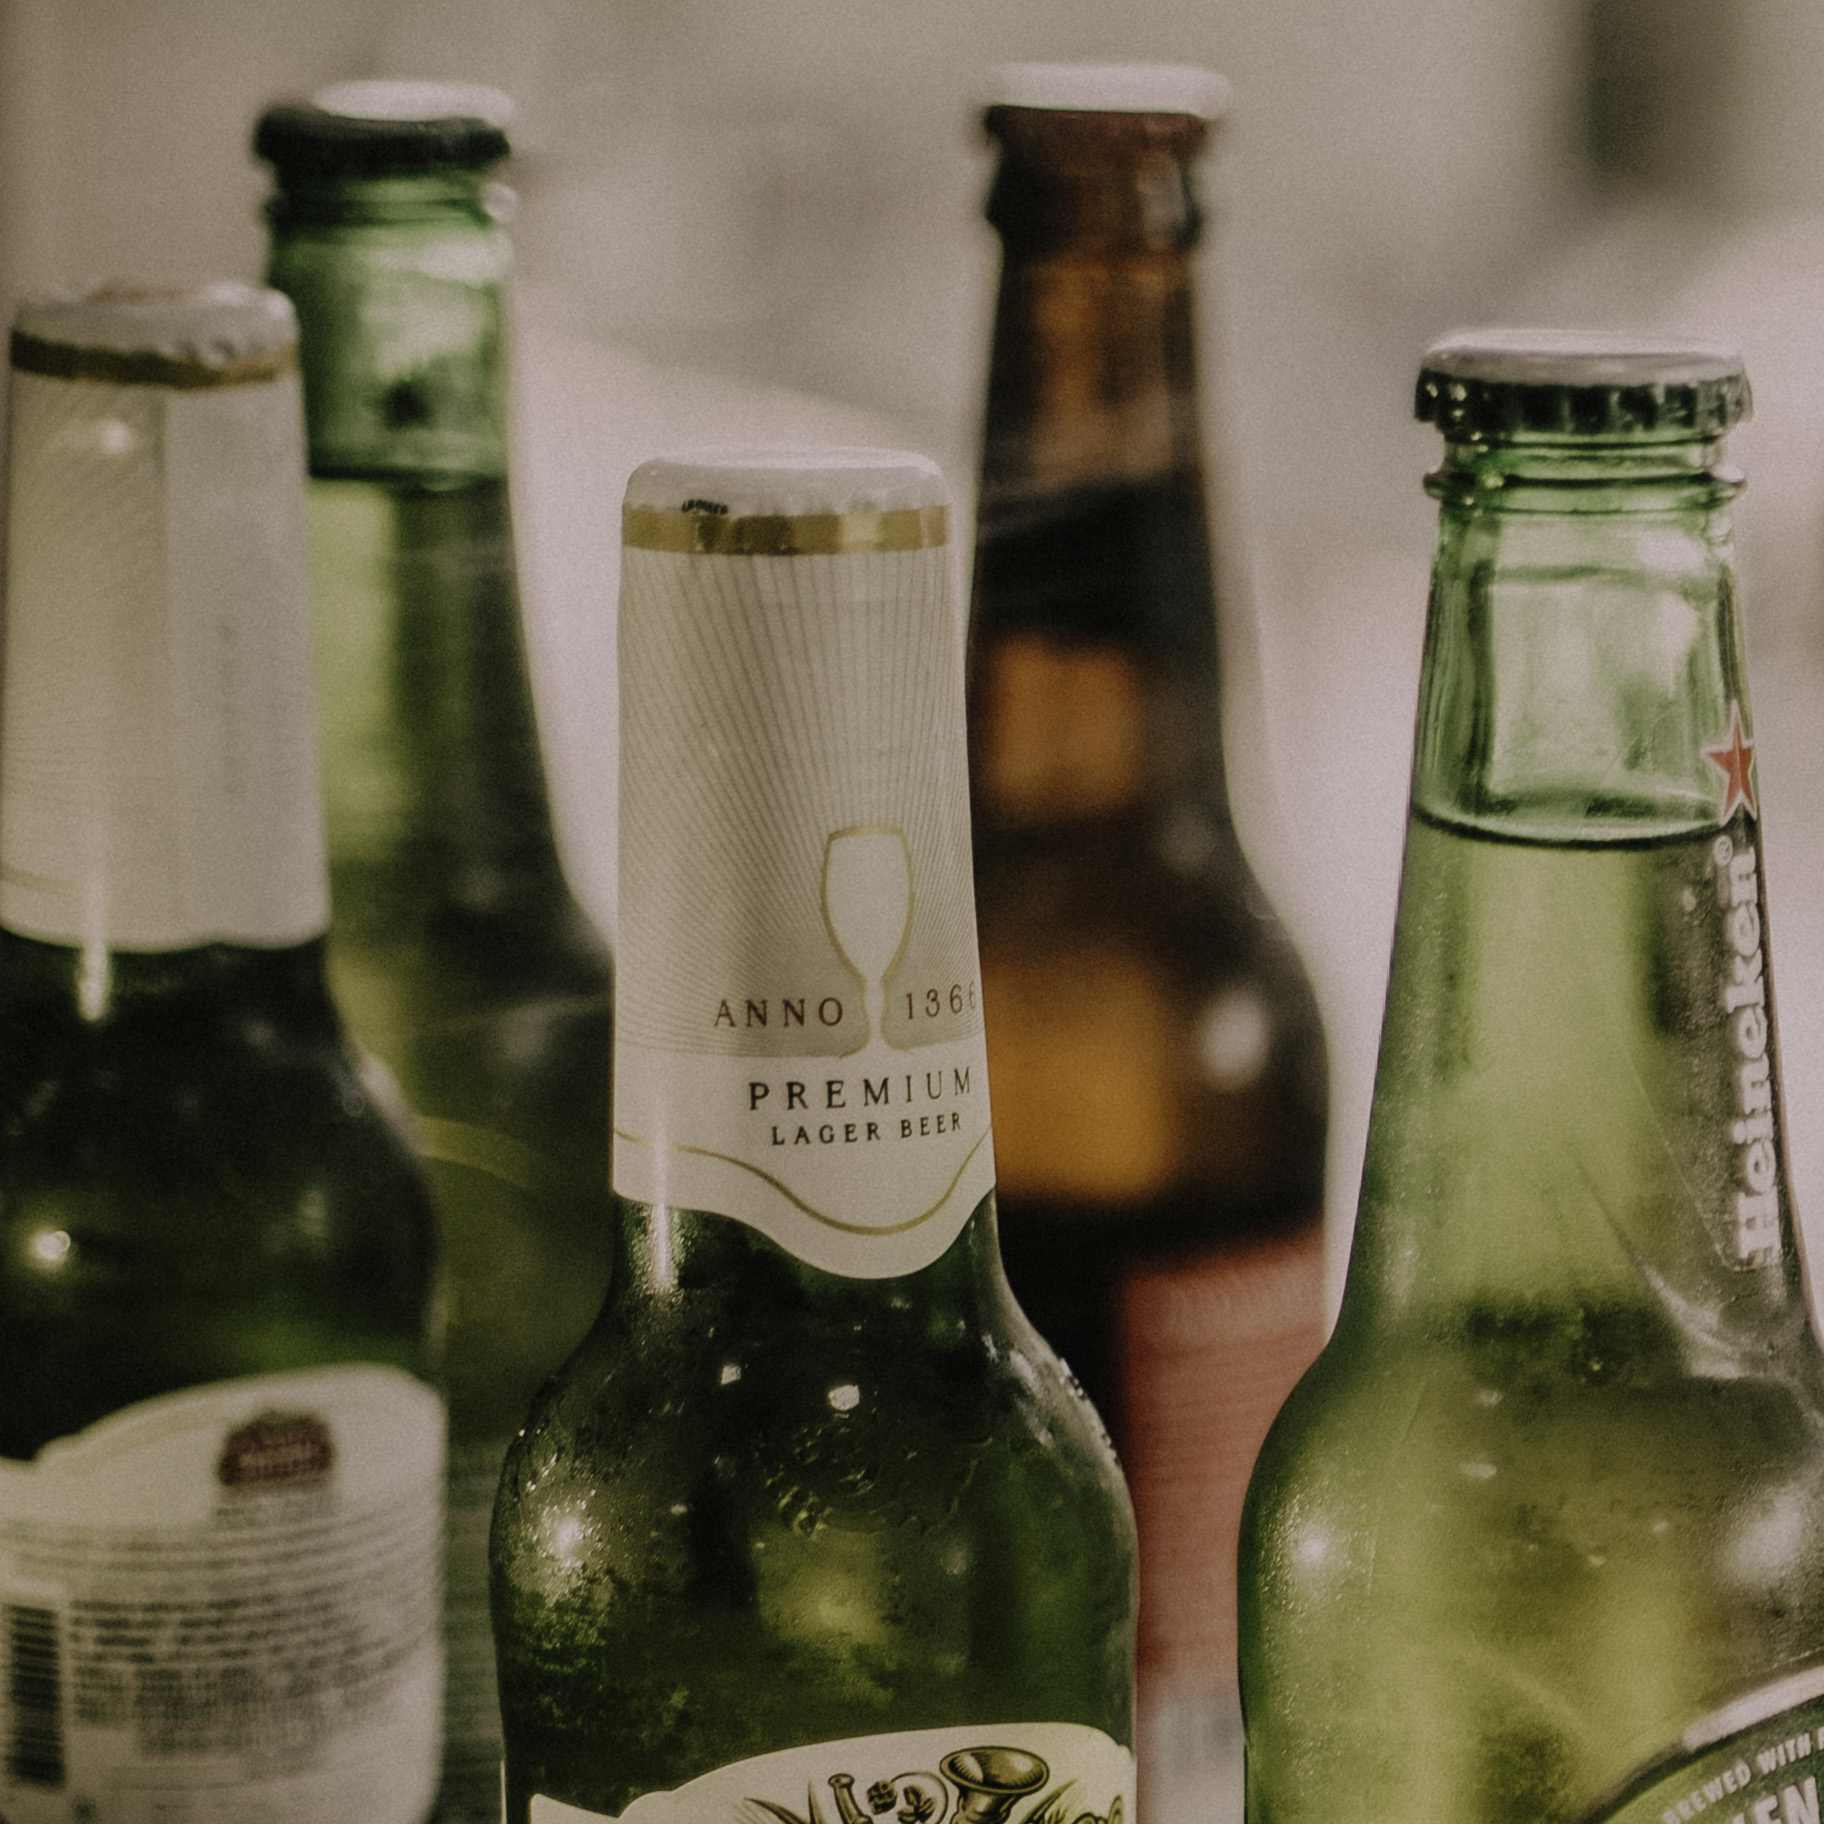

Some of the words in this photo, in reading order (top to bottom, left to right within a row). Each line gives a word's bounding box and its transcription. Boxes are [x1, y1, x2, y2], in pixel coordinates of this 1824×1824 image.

[714, 997, 844, 1028] ANNO
[748, 1066, 972, 1111] PREMIUM
[771, 1121, 881, 1147] LAGER
[900, 1111, 962, 1140] BEER
[1756, 1732, 1812, 1776] WITH
